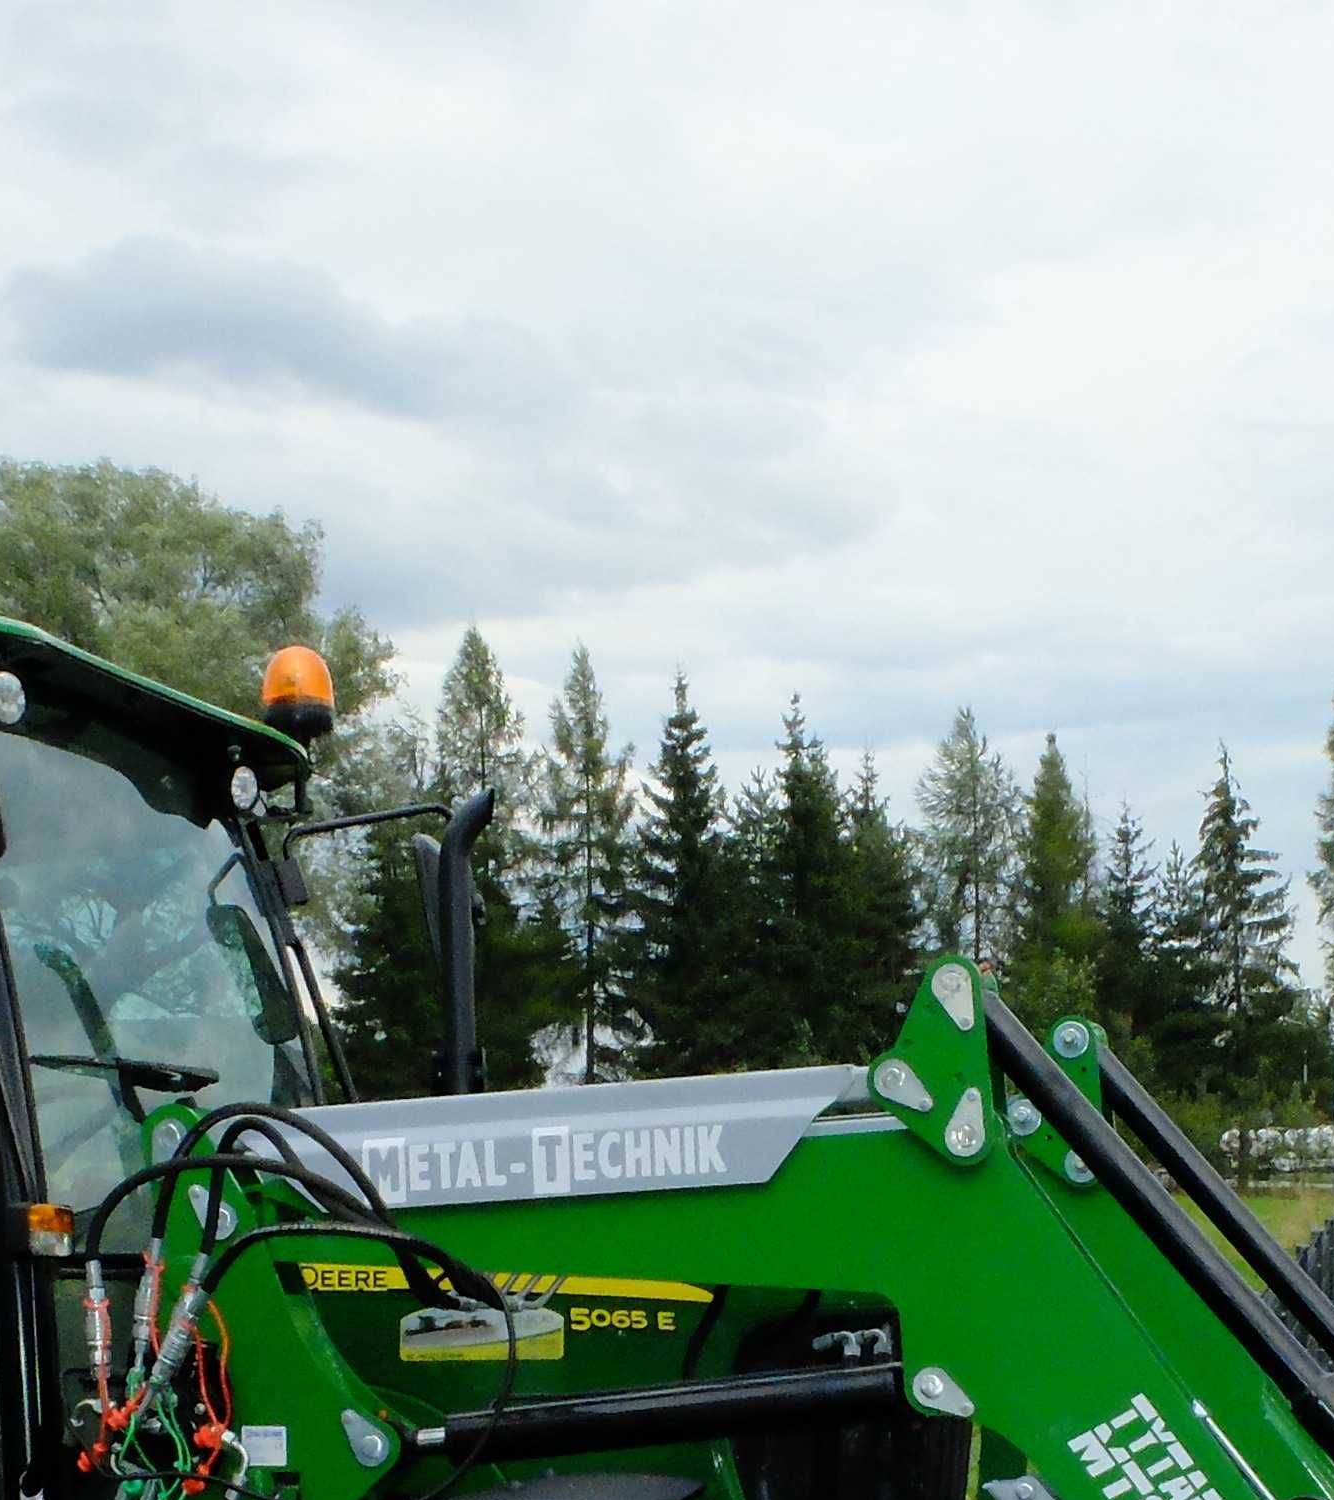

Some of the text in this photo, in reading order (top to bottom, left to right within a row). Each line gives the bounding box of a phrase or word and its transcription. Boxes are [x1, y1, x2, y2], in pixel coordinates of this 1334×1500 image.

[363, 1124, 728, 1202] METAL-TECHNIK
[300, 1266, 388, 1288] DEERE
[570, 1307, 676, 1331] 5065 E
